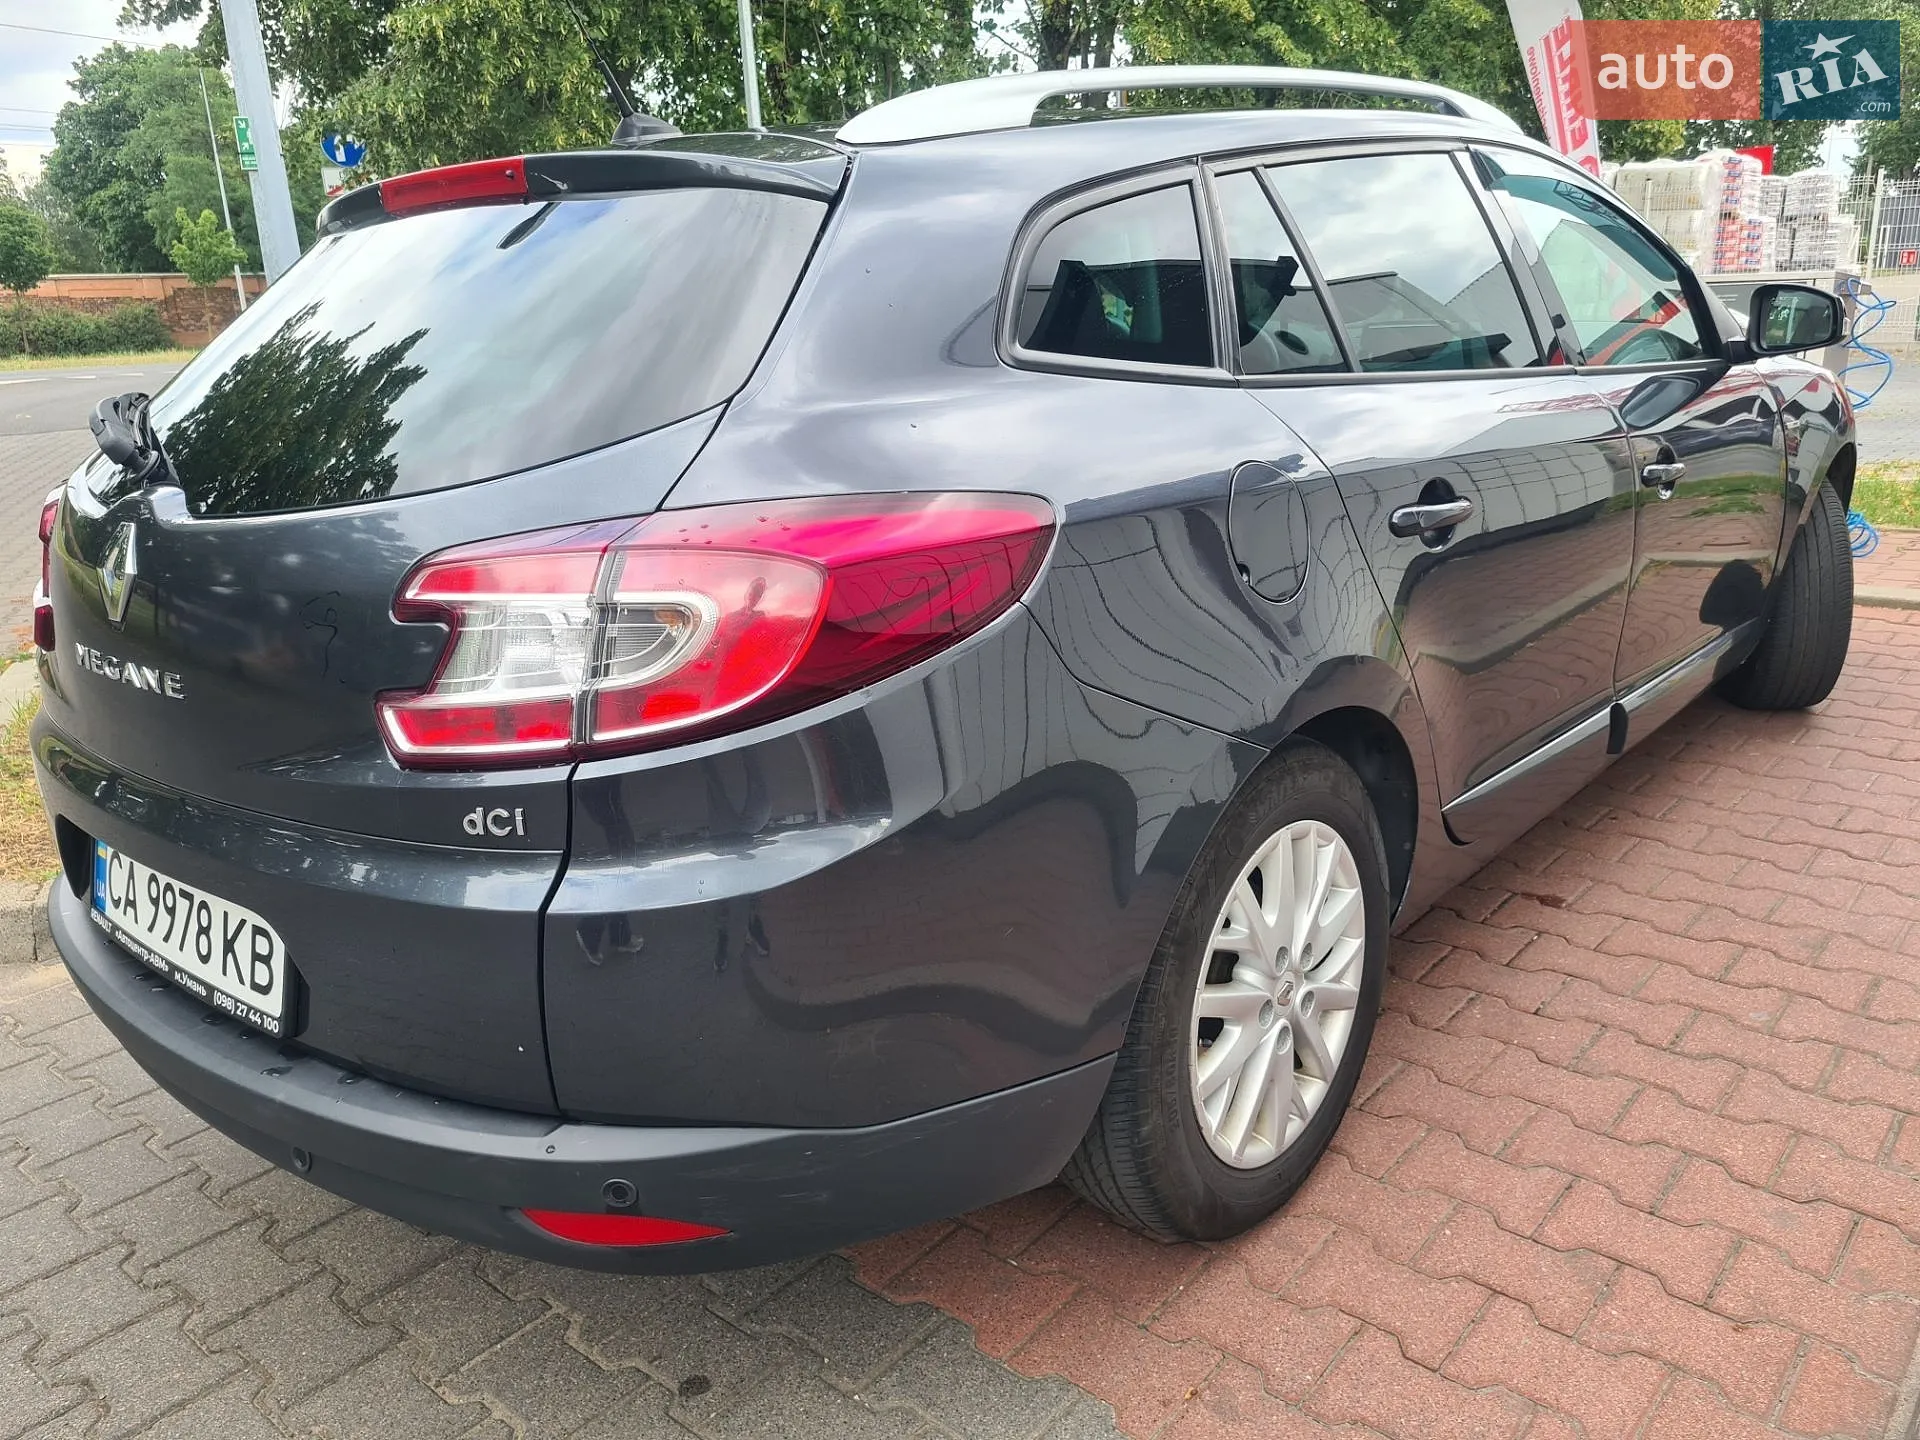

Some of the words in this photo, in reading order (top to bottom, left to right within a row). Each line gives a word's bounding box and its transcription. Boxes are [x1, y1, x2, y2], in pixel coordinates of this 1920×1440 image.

[75, 642, 187, 700] MEGANE
[96, 879, 106, 901] UA
[108, 850, 139, 925] CA
[147, 873, 212, 965] 9978
[222, 911, 274, 996] KB
[213, 990, 235, 1015] (098)
[236, 1002, 248, 1018] 27
[249, 1009, 262, 1025] 44
[262, 1014, 279, 1033] 100
